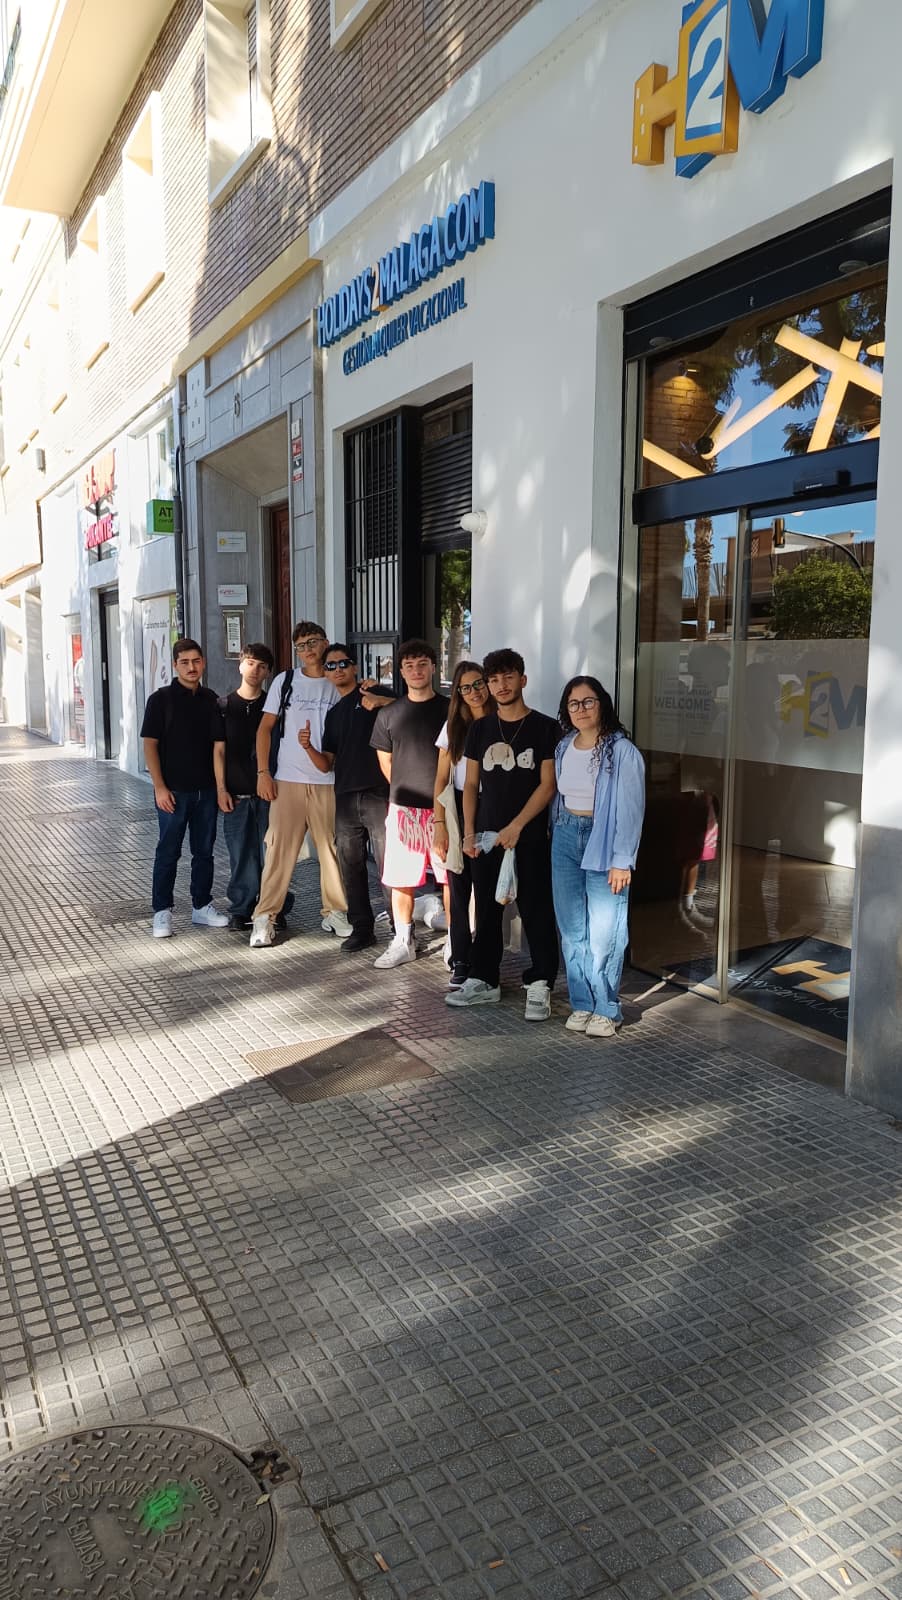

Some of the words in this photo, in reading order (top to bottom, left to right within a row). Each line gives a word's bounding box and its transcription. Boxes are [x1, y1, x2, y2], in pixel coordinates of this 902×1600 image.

[632, 0, 825, 178] H2M
[317, 181, 495, 348] HOLIDAYS2MALAGA.COM
[342, 331, 372, 376] GESTIÓN
[372, 312, 409, 358] ALQUILER
[408, 277, 468, 338] VACACIONAL
[654, 695, 713, 712] WELCOME
[780, 670, 867, 739] H2M
[67, 1521, 106, 1581] EMASA
